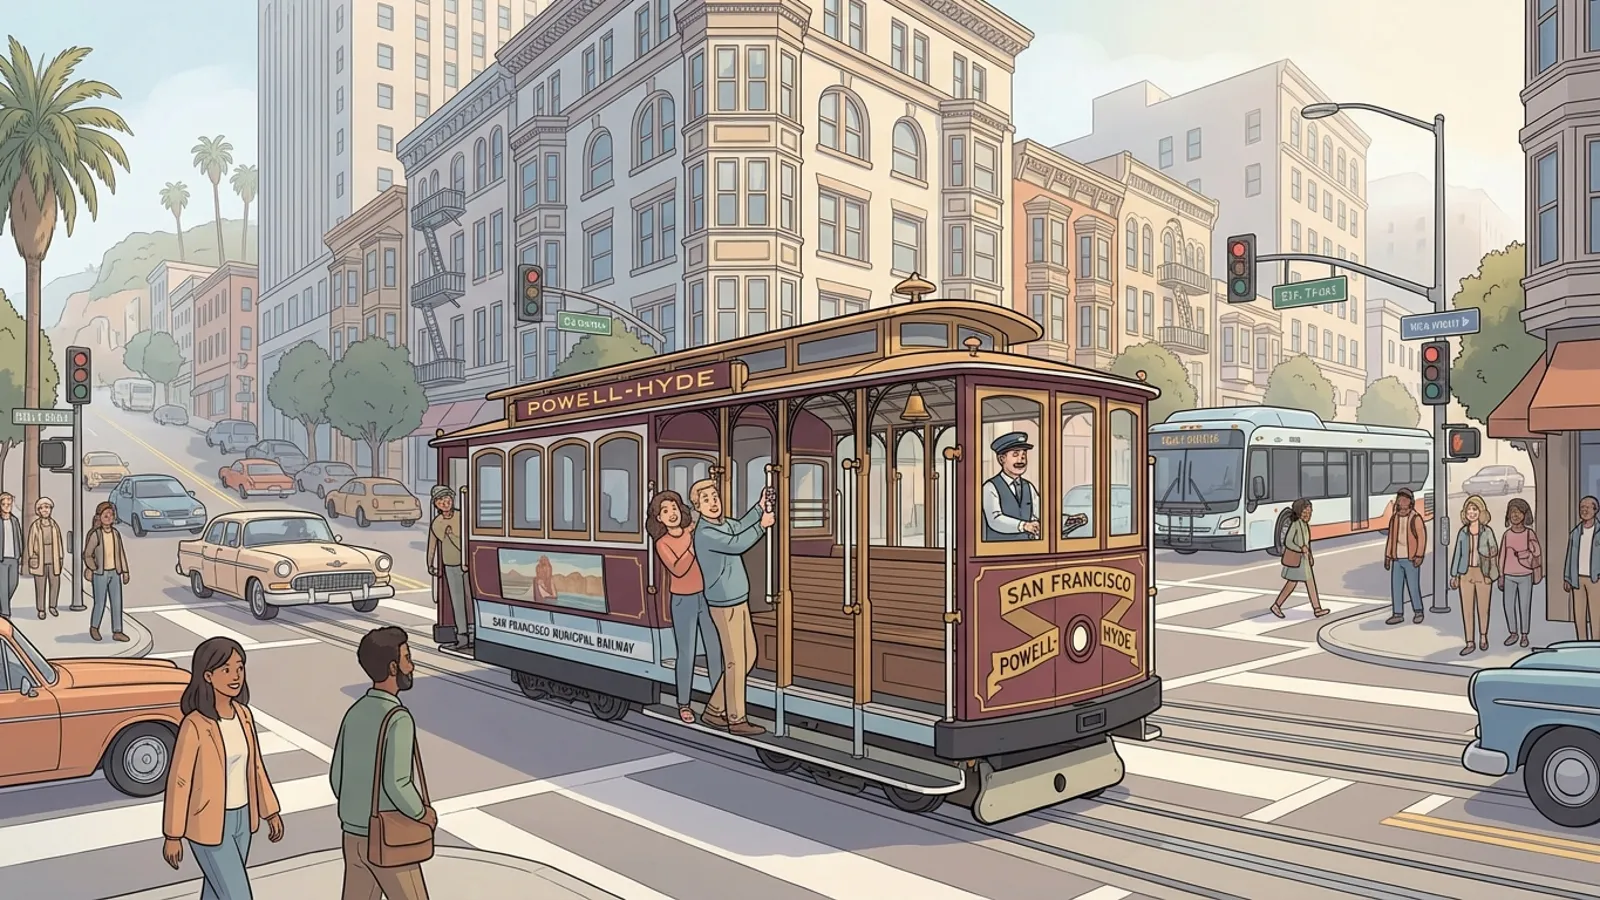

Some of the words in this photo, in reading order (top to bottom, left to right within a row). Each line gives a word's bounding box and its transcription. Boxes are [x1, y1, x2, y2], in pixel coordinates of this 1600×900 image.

[527, 369, 715, 416] POWELL-HYDE
[1007, 577, 1044, 605] SAN
[1051, 571, 1131, 593] FRANCISCO
[1000, 635, 1057, 675] POWELL-
[1103, 625, 1132, 650] HYDE
